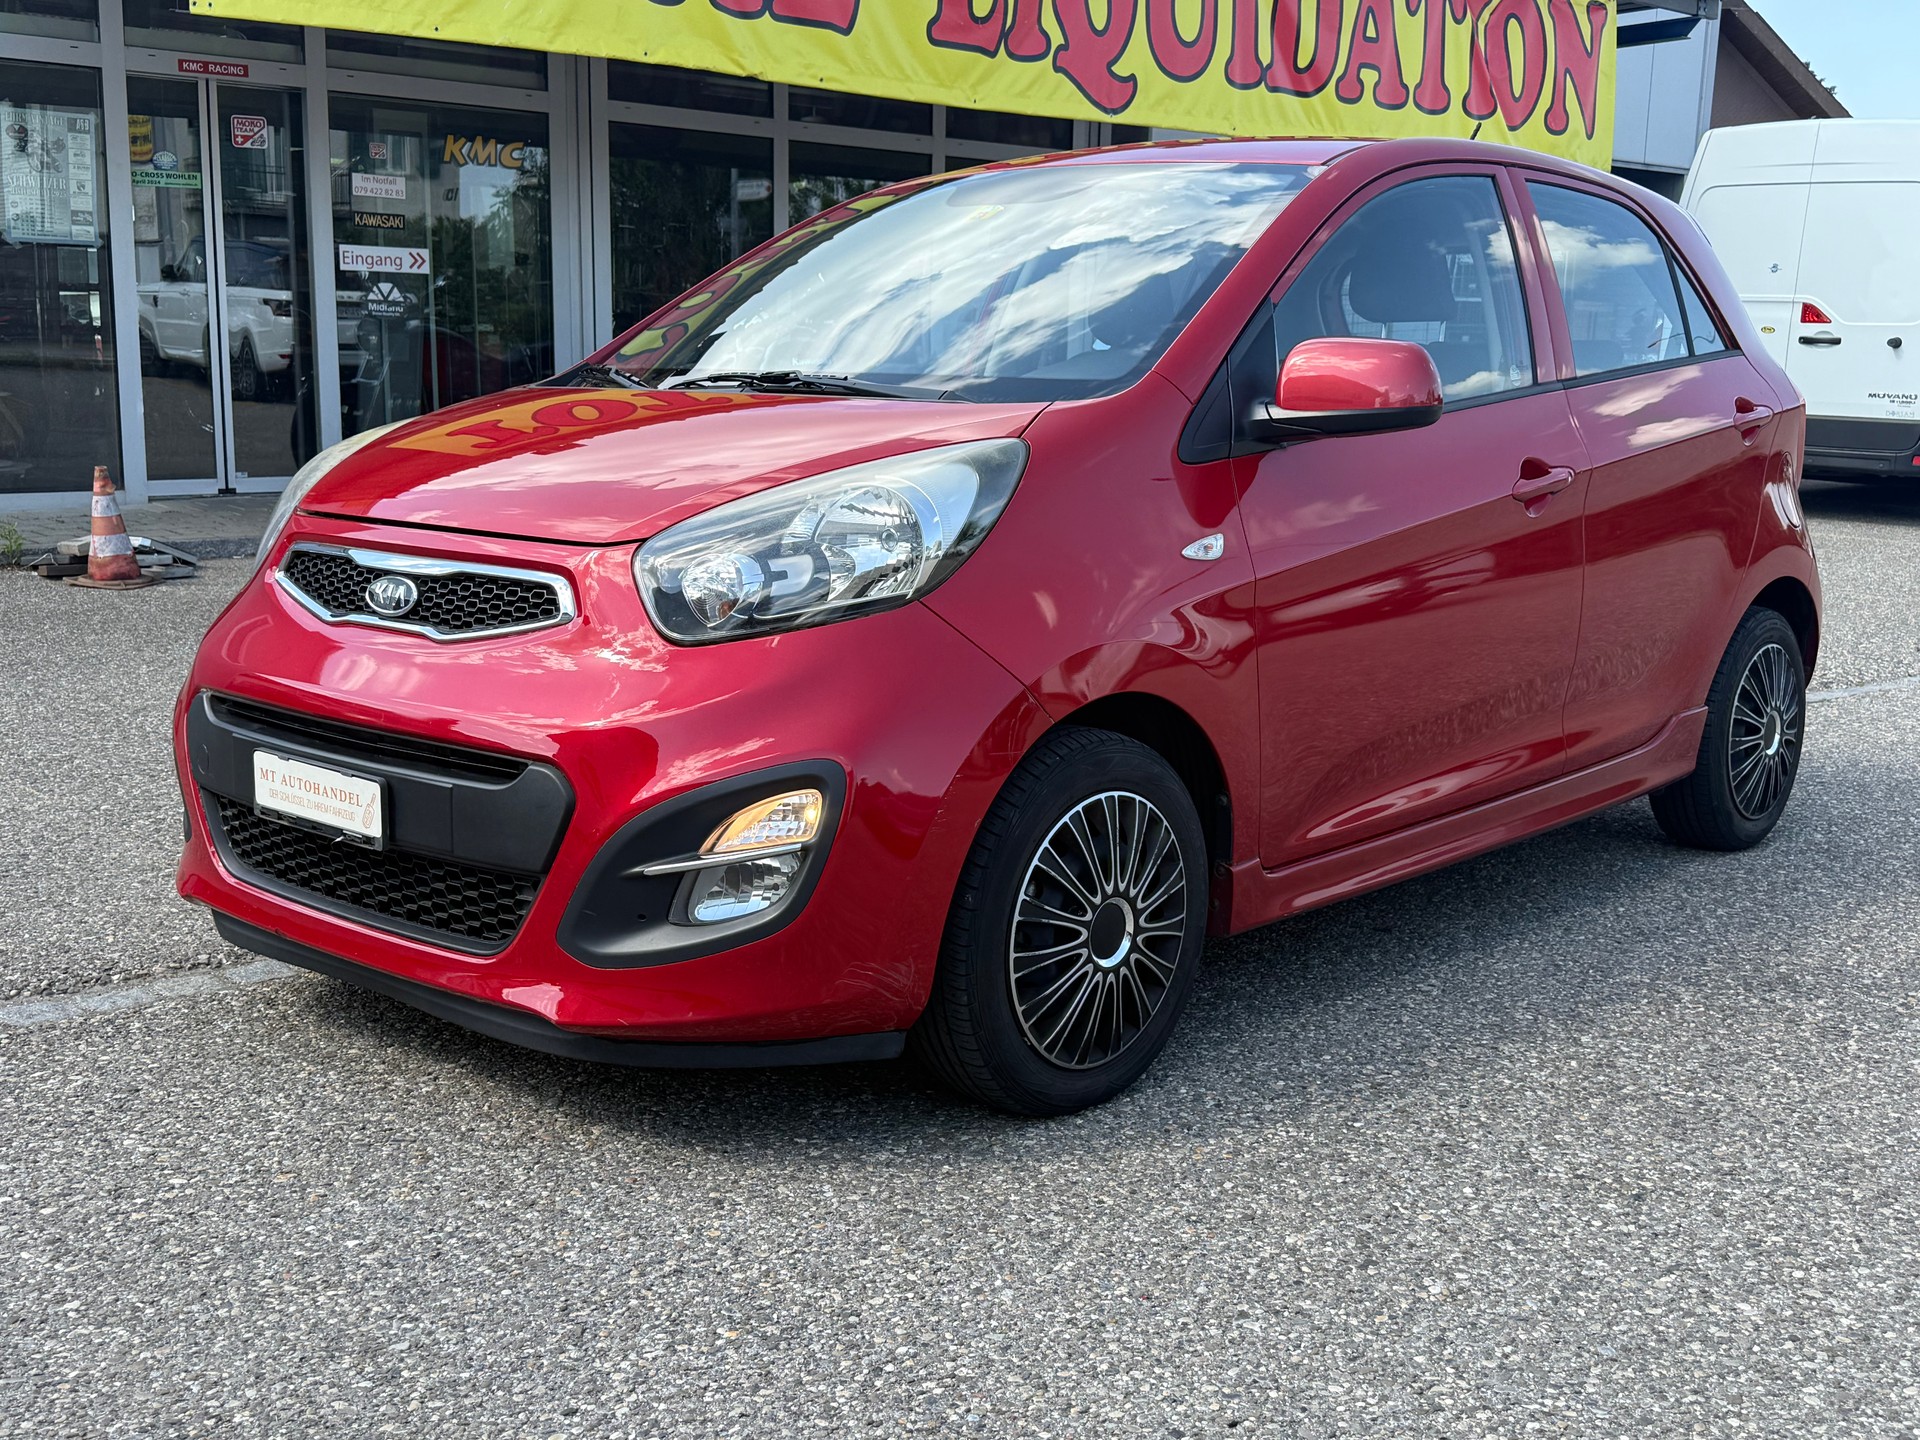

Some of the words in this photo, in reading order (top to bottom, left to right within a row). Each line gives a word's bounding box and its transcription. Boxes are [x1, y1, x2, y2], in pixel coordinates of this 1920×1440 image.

[182, 62, 204, 72] KMC
[208, 64, 245, 75] RACING
[235, 119, 262, 128] MOKO
[442, 133, 526, 169] KMC
[165, 172, 198, 180] WOHLEN
[361, 175, 372, 184] Im
[373, 176, 397, 186] Notfall
[354, 186, 368, 195] 079
[370, 187, 383, 196] 422
[385, 188, 394, 197] 82
[354, 212, 404, 229] KAWASAKI
[342, 250, 403, 271] Eingang
[1867, 392, 1918, 400] MOVANO
[374, 581, 407, 608] KIA
[260, 767, 276, 783] MT
[281, 773, 363, 808] AUTOHANDEL
[269, 788, 279, 798] DER
[279, 790, 306, 808] SCHLÜSSEL
[306, 798, 314, 810] ZU
[329, 804, 356, 822] FAHRZEUG
